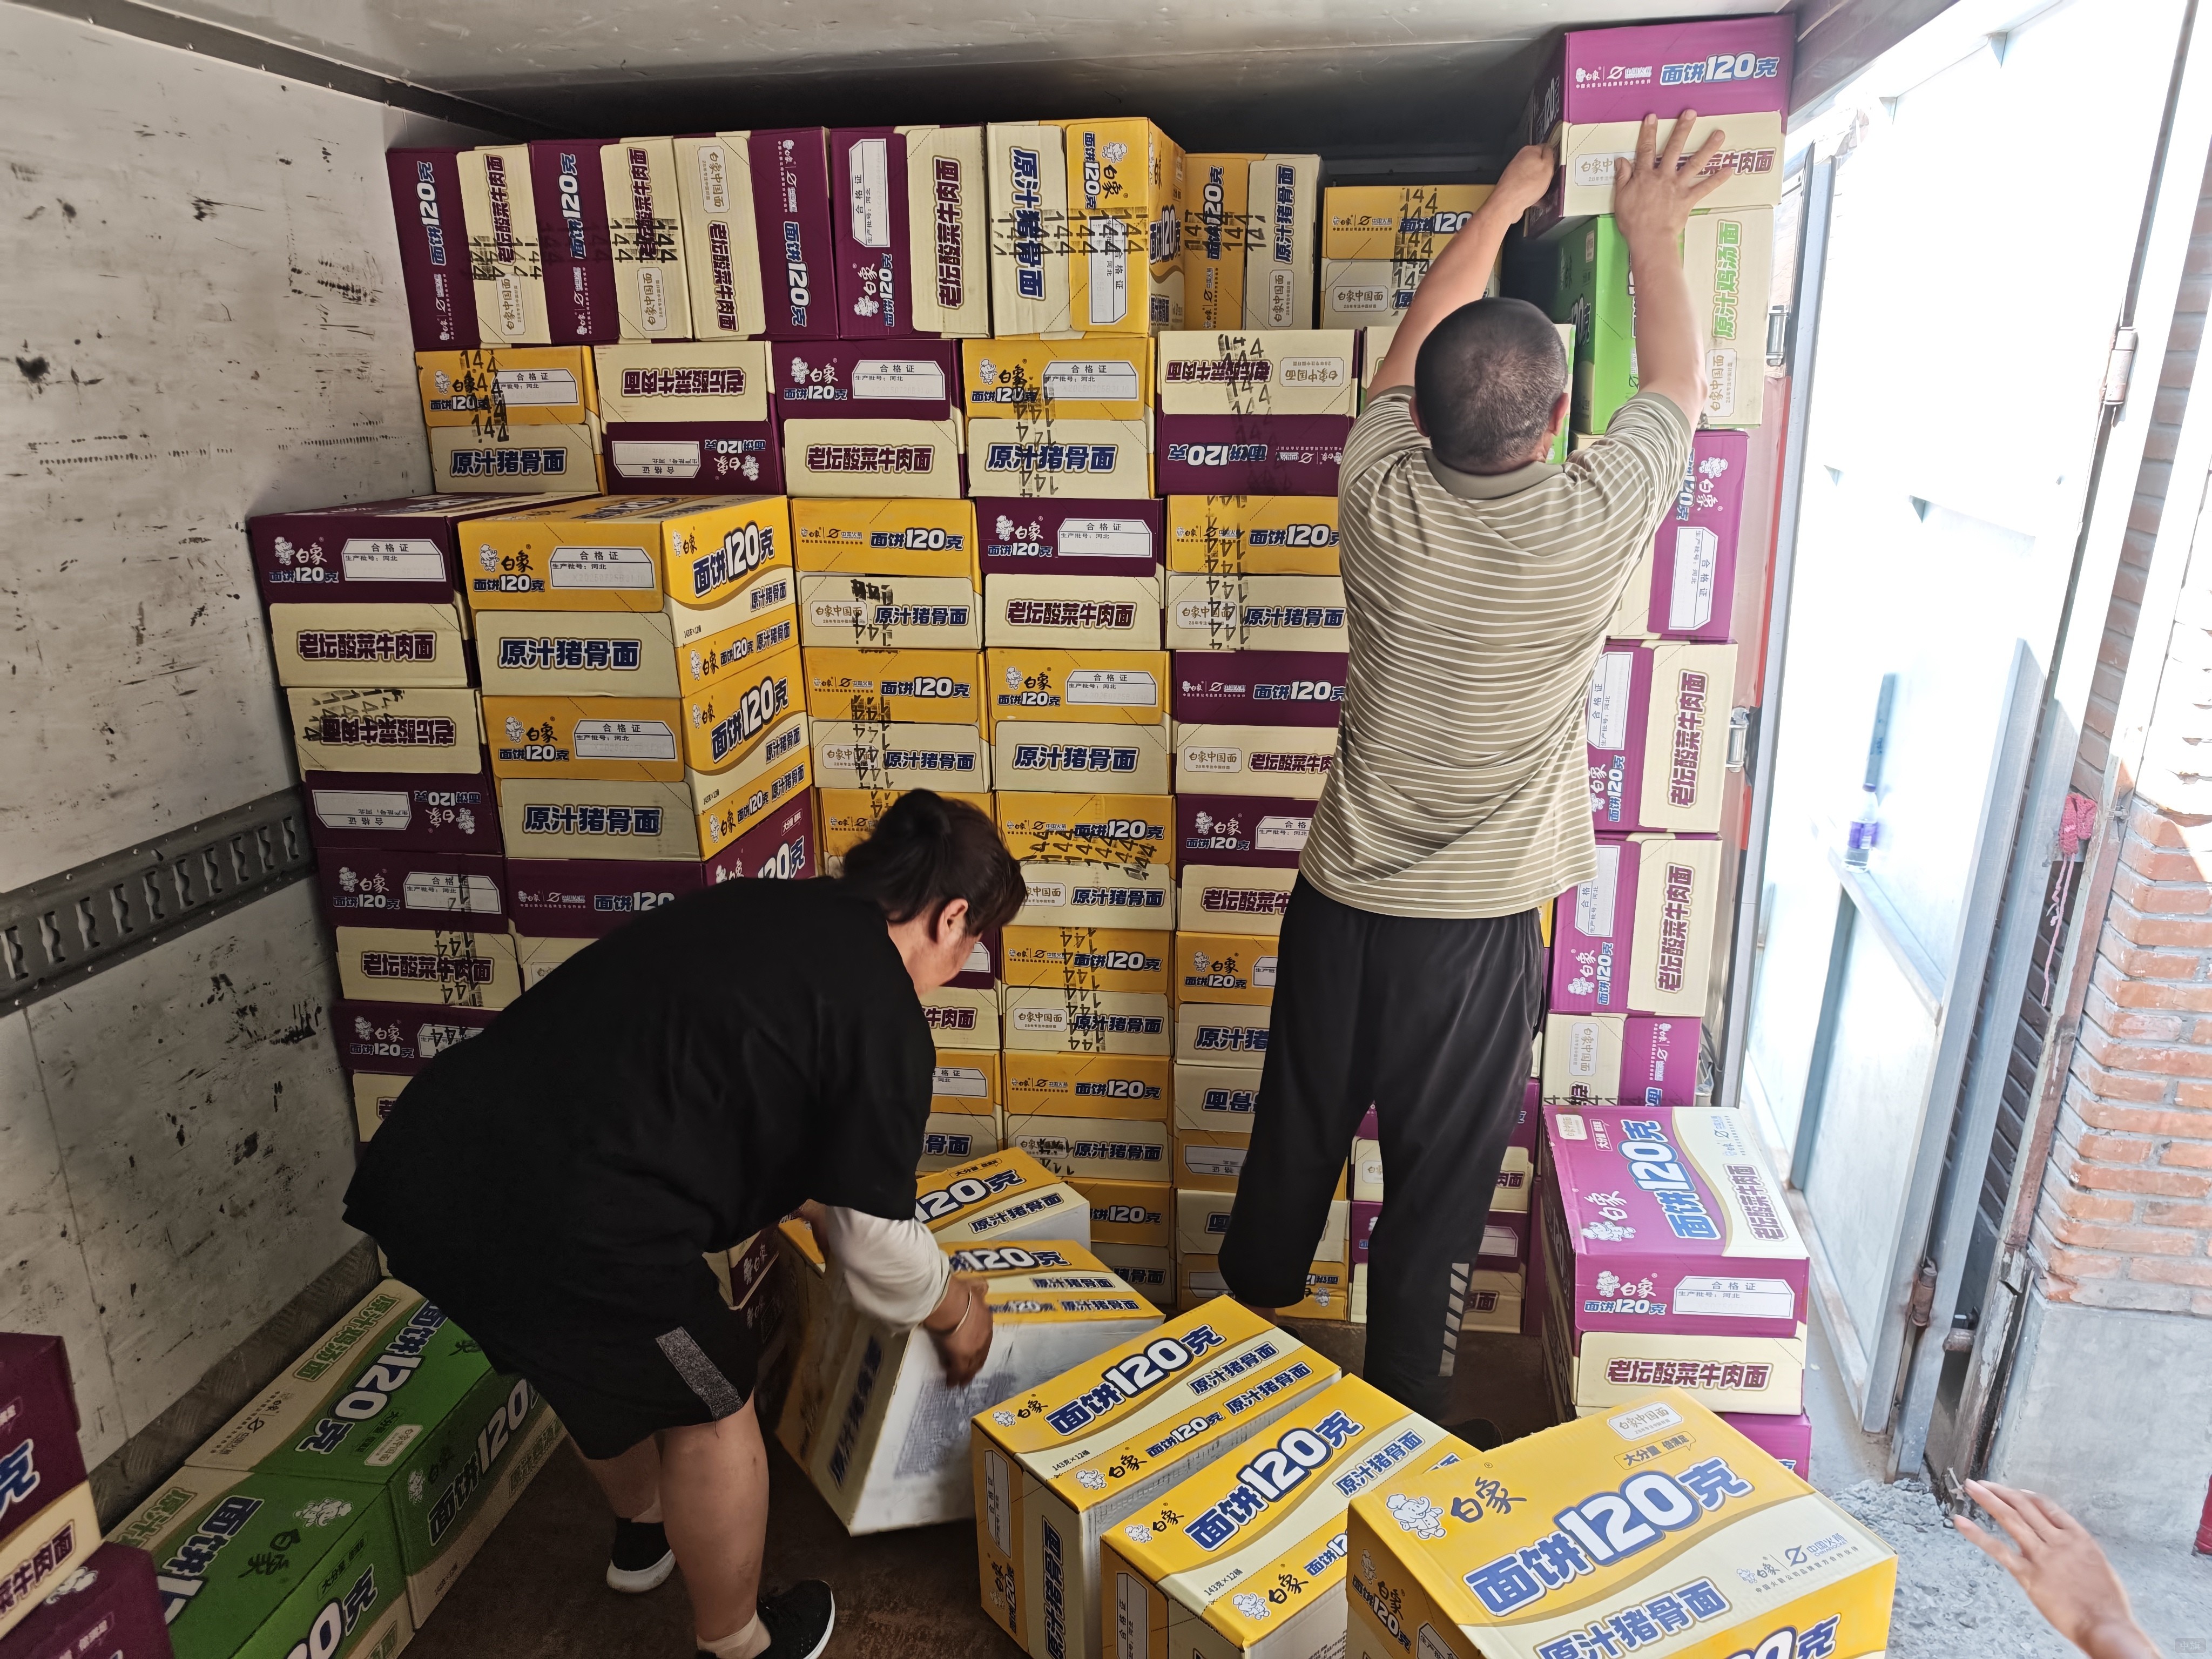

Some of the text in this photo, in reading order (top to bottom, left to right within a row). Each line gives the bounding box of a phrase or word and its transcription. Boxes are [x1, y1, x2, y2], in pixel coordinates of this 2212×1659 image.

[1660, 53, 1779, 86] 面饼120克
[708, 152, 725, 208] 白象中国面
[1083, 132, 1101, 210] 面饼120克
[1103, 164, 1122, 199] 白象
[558, 153, 586, 259] 面饼120克
[855, 174, 864, 214] 合格证
[416, 160, 447, 266] 面饼120克
[1011, 147, 1046, 300] 原汁猪骨面
[1275, 164, 1295, 264] 原汁猪骨面
[934, 157, 961, 308] 老坛酸菜牛肉面
[708, 221, 739, 332] 老坛酸菜牛肉面
[783, 221, 810, 327] 面饼120克
[858, 262, 877, 294] 白象
[1712, 219, 1742, 340] 原汁鸡汤面
[646, 272, 656, 326] 白象中国面
[879, 253, 893, 327] 面饼120克
[1273, 274, 1284, 322] 白象中国面
[1338, 291, 1384, 302] 白象中国面
[517, 372, 549, 381] 合格证
[622, 369, 746, 396] 老坛酸菜牛肉面
[810, 363, 839, 384] 白象
[880, 365, 915, 373] 合格证
[1071, 365, 1107, 374] 合格证
[1285, 368, 1338, 382] 白象中国面
[784, 386, 847, 400] 面饼120克
[1710, 354, 1724, 412] 白象中国面
[705, 439, 766, 452] 面饼120克
[986, 444, 1118, 473] 原汁猪骨面
[1168, 443, 1267, 467] 面饼120克
[451, 448, 568, 476] 原汁猪骨面
[643, 466, 675, 475] 合格证
[714, 456, 741, 475] 白象
[806, 446, 935, 473] 老坛酸菜牛肉面
[1696, 478, 1719, 511] 白象
[871, 528, 963, 550] 面饼120克
[1014, 520, 1043, 541] 白象
[1086, 523, 1122, 531] 合格证
[295, 543, 327, 564] 白象
[371, 544, 409, 552] 合格证
[580, 551, 618, 561] 合格证
[683, 530, 698, 555] 白象
[988, 542, 1052, 557] 面饼120克
[502, 551, 534, 572] 白象
[693, 522, 774, 597] 面饼120克
[269, 567, 339, 583] 面饼120克
[474, 576, 544, 592] 面饼120克
[1700, 558, 1710, 597] 合格证
[750, 579, 787, 612] 原汁猪骨面
[874, 605, 969, 626] 原汁猪骨面
[1007, 599, 1137, 629] 老坛酸菜牛肉面
[1245, 608, 1345, 628] 原汁猪骨面
[298, 631, 435, 661] 老坛酸菜牛肉面
[756, 621, 790, 652] 原汁猪骨面
[498, 638, 641, 671] 原汁猪骨面
[703, 648, 719, 676] 白象
[720, 638, 753, 665] 面饼120克
[880, 677, 970, 698] 面饼120克
[1024, 669, 1051, 690] 白象
[1094, 673, 1128, 682] 合格证
[997, 692, 1061, 706] 面饼120克
[1591, 684, 1603, 720] 合格证
[702, 702, 716, 725] 白象
[711, 677, 789, 763] 面饼120克
[320, 716, 456, 746] 老坛酸菜牛肉面
[526, 724, 558, 743] 白象
[603, 724, 641, 733] 合格证
[1668, 671, 1708, 810] 老坛酸菜牛肉面
[500, 745, 569, 762] 面饼120克
[766, 726, 800, 763] 原汁猪骨面
[1013, 744, 1139, 772] 原汁猪骨面
[1189, 751, 1236, 764] 白象中国面
[886, 750, 975, 771] 原汁猪骨面
[1250, 753, 1333, 774] 老坛酸菜牛肉
[771, 763, 805, 800] 原汁猪骨面
[1608, 756, 1626, 824] 面饼120克
[415, 792, 481, 806] 面饼120克
[738, 791, 768, 821] 面饼120克
[426, 809, 455, 828] 白象
[524, 806, 663, 835] 原汁猪骨面
[721, 809, 737, 836] 白象
[1074, 820, 1164, 840] 面饼120克
[1215, 817, 1242, 836] 白象
[1186, 837, 1249, 851] 面饼120克
[360, 871, 389, 894] 白象
[334, 894, 400, 911] 面饼120克
[1071, 887, 1165, 908] 原汁猪骨面
[1655, 862, 1695, 993] 老坛酸菜牛肉面
[1074, 951, 1161, 972] 面饼120克
[1211, 958, 1238, 975] 白象
[1575, 950, 1596, 977] 白象
[1597, 942, 1614, 1005] 面饼120克
[1184, 974, 1246, 988] 面饼120克
[1018, 1010, 1062, 1023] 白象中国面
[1073, 1015, 1164, 1034] 原汁猪骨面
[375, 1024, 404, 1042] 白象
[350, 1043, 414, 1058] 面饼120克
[1581, 1027, 1594, 1072] 白象中国面
[1075, 1081, 1161, 1100] 面饼120克
[1074, 1141, 1163, 1161] 原汁猪骨面
[1619, 1120, 1721, 1239] 面饼120克
[970, 1193, 1064, 1234] 原汁猪骨面
[1585, 1190, 1627, 1221] 白象
[1724, 1164, 1788, 1241] 老坛酸菜牛肉面
[1620, 1279, 1656, 1298] 白象
[1712, 1282, 1756, 1291] 合格证
[1584, 1300, 1667, 1316] 面饼120克
[294, 1294, 400, 1381] 原汁鸡汤面
[295, 1300, 448, 1454] 面饼120克
[1045, 1323, 1227, 1436] 面饼120克
[1186, 1343, 1280, 1396] 原汁猪骨面
[1605, 1358, 1773, 1392] 老坛酸菜牛肉面
[1224, 1361, 1313, 1415] 原汁猪骨面
[1017, 1399, 1049, 1419] 白象
[1620, 1407, 1669, 1429] 白象中国面
[1145, 1412, 1225, 1458] 面饼120克
[1051, 1450, 1090, 1472] 143克×12桶
[1109, 1452, 1148, 1480] 白象
[1334, 1428, 1425, 1497] 原汁猪骨面
[1623, 1445, 1662, 1466] 大分量
[1184, 1410, 1365, 1552] 面饼120克
[1450, 1478, 1527, 1522] 白象
[1152, 1508, 1184, 1533] 白象
[1463, 1456, 1755, 1617] 面饼120克
[1806, 1533, 1845, 1554] 中国火箭
[1204, 1569, 1243, 1597] 143克×12桶
[1269, 1569, 1309, 1604] 白象
[1353, 1573, 1412, 1654] 面饼120克
[1535, 1576, 1733, 1659] 原汁猪骨面
